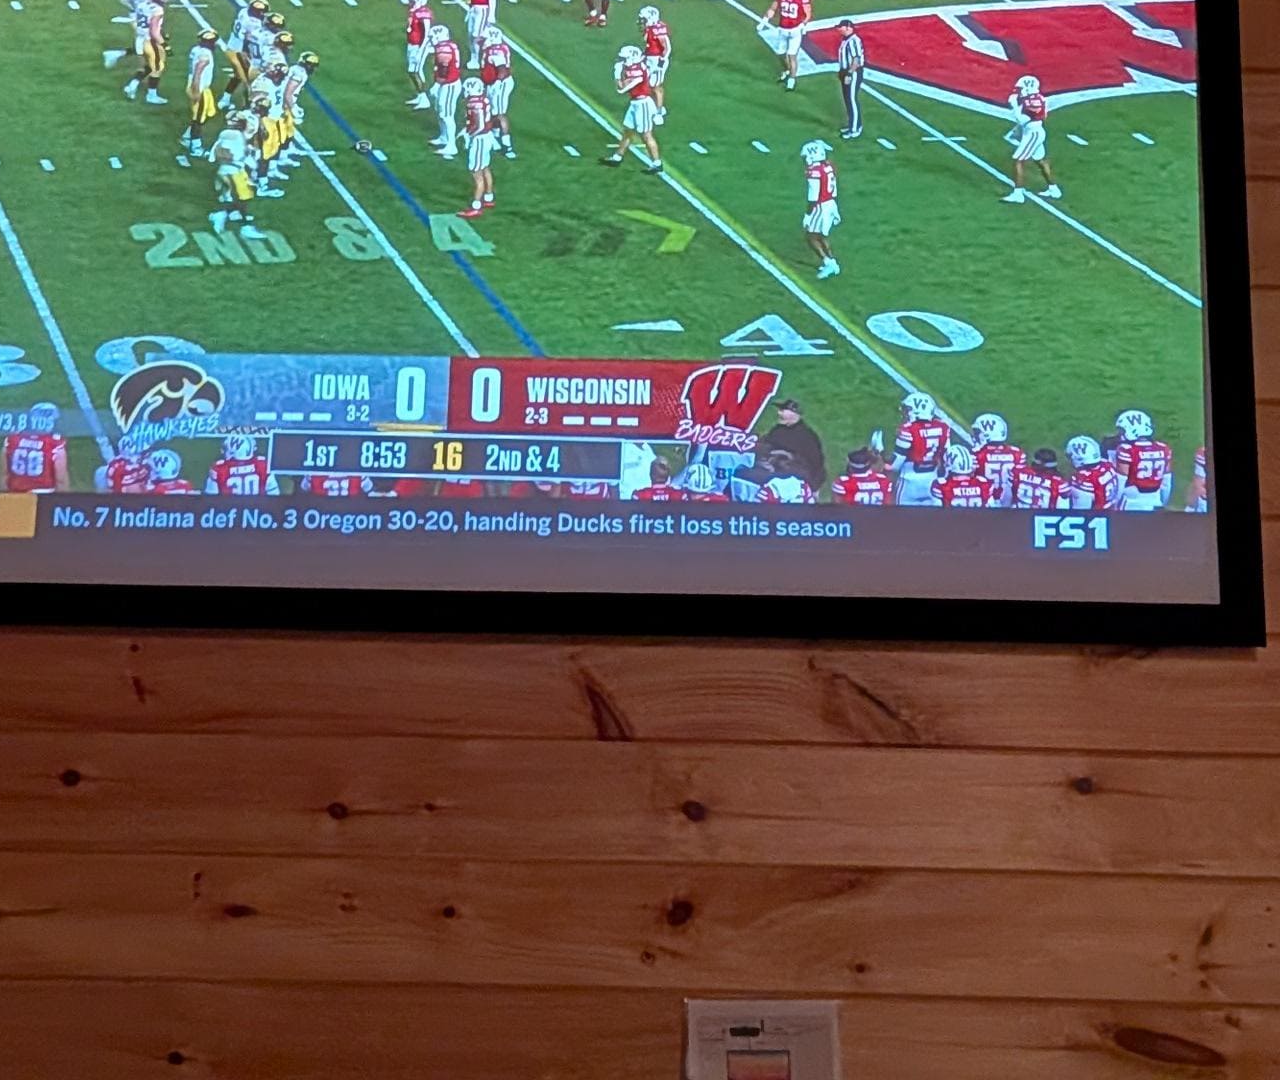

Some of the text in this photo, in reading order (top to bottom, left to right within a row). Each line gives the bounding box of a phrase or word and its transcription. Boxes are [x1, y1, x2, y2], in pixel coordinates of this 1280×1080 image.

[130, 223, 297, 268] 2ND
[429, 214, 496, 256] 4
[313, 367, 426, 421] IOWA 0
[471, 367, 651, 422] 0 WISCONSIN
[681, 364, 782, 433] W
[131, 414, 220, 444] HAWKEYES
[346, 405, 370, 421] 3-2
[525, 407, 549, 424] 2-3
[675, 419, 758, 452] BADGERS
[303, 439, 560, 472] 1ST 8:53 16 2ND & 4
[53, 507, 851, 538] No. 7 Indiana def No. 3 Oregon 30-20, handing Ducks first loss this season
[1033, 515, 1109, 549] FS1
